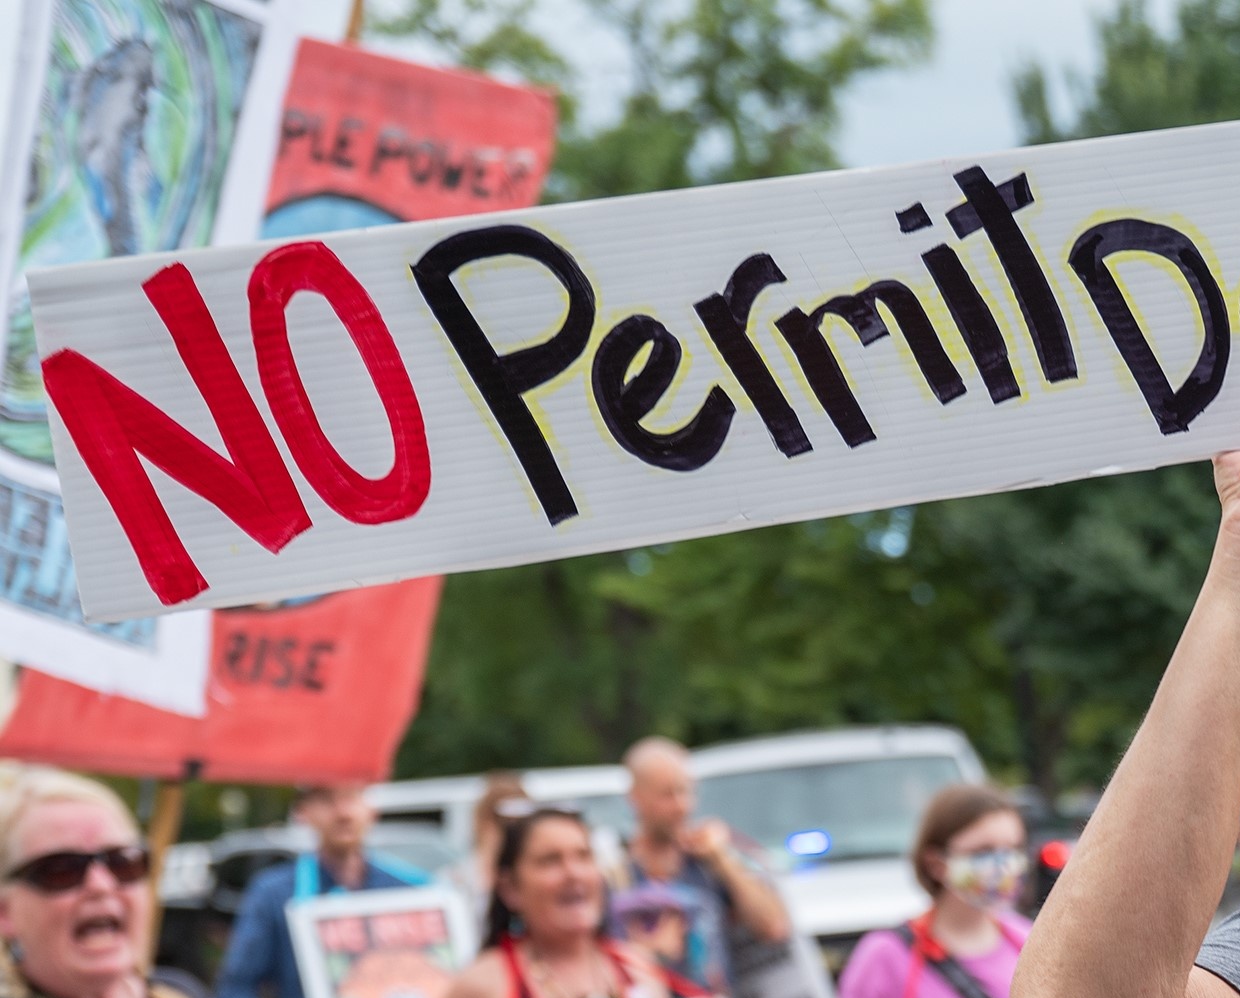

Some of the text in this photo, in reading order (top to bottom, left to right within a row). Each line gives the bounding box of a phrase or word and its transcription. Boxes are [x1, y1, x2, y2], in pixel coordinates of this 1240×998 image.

[41, 241, 431, 605] NO
[409, 165, 1078, 527] Permit
[224, 630, 336, 693] RISE
